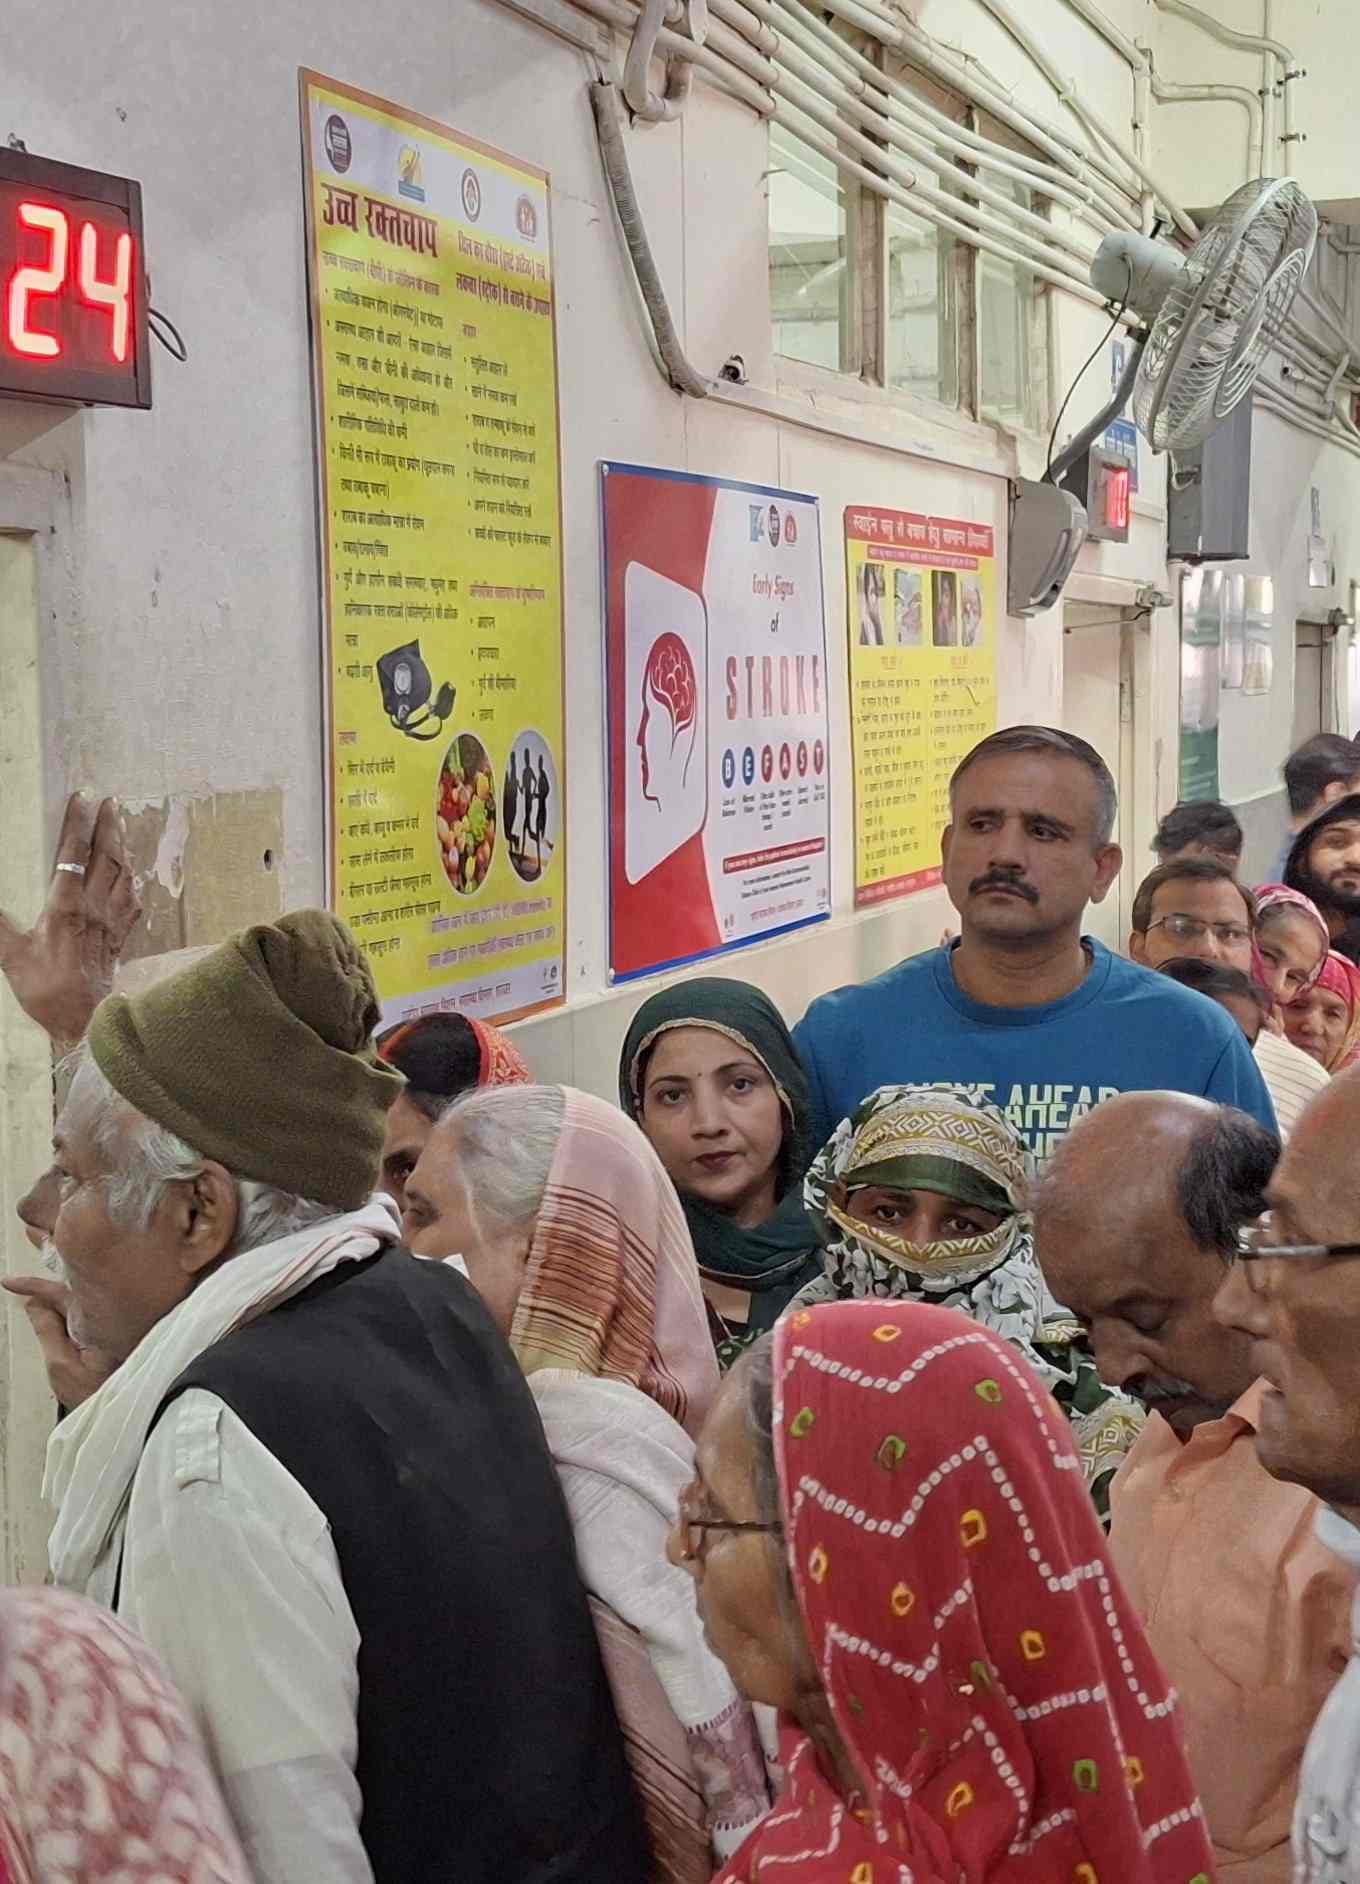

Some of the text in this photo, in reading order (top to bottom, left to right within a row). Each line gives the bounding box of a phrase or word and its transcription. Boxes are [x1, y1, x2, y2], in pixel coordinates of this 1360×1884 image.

[320, 182, 439, 258] उच्च रक्तचाप
[9, 202, 132, 362] 24
[751, 571, 771, 598] Early
[770, 612, 780, 633] of
[724, 653, 821, 721] STROKE
